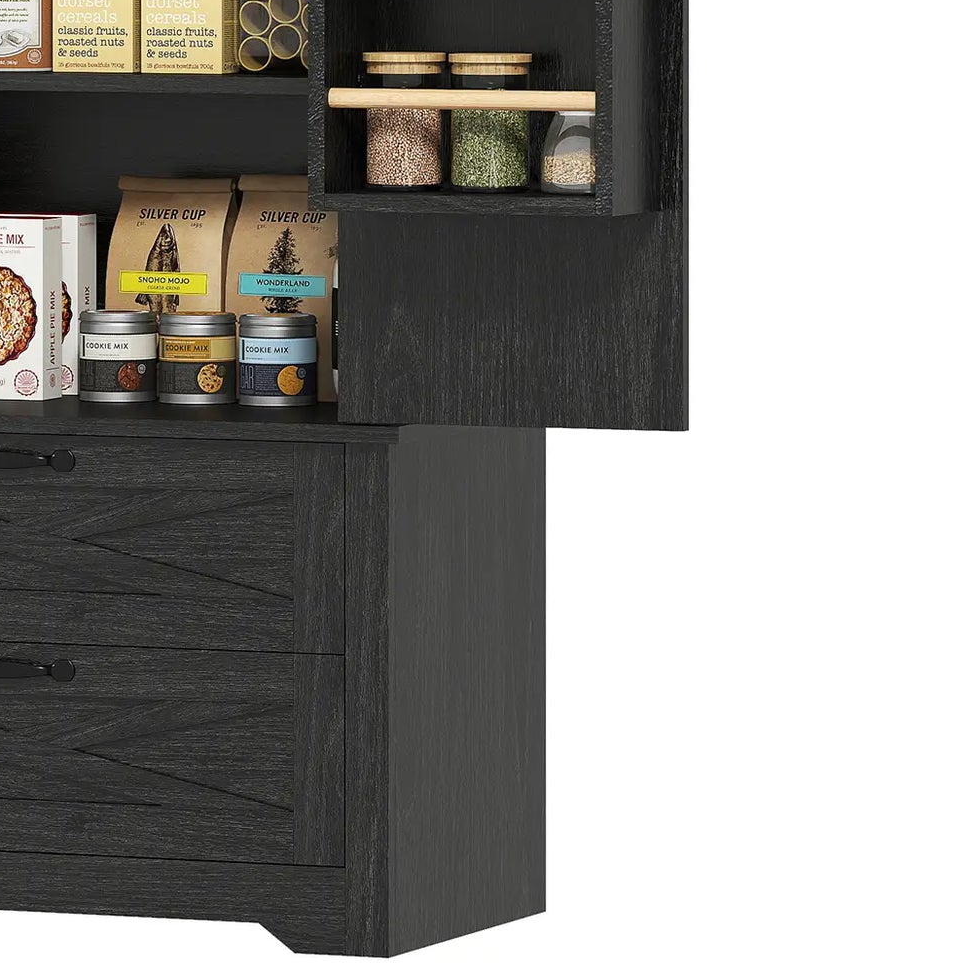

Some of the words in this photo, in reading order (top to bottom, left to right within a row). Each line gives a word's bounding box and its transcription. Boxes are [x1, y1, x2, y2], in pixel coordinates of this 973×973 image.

[58, 10, 117, 23] cereals
[146, 11, 206, 25] cereals
[58, 26, 93, 35] classic
[95, 26, 128, 36] fruits,
[147, 27, 181, 36] classic
[184, 27, 217, 37] fruits,
[58, 38, 97, 46] roasted
[147, 39, 186, 47] roasted
[189, 39, 213, 47] nuts
[58, 49, 68, 57] &
[70, 49, 98, 57] seeds
[147, 50, 156, 58] &
[158, 49, 187, 58] seeds
[139, 208, 179, 219] SILVER
[182, 209, 206, 220] CUP
[260, 211, 299, 223] SILVER
[302, 212, 326, 224] CUP
[6, 234, 24, 245] MIX
[256, 279, 310, 287] WONDERLAND
[86, 342, 111, 350] COOKIE
